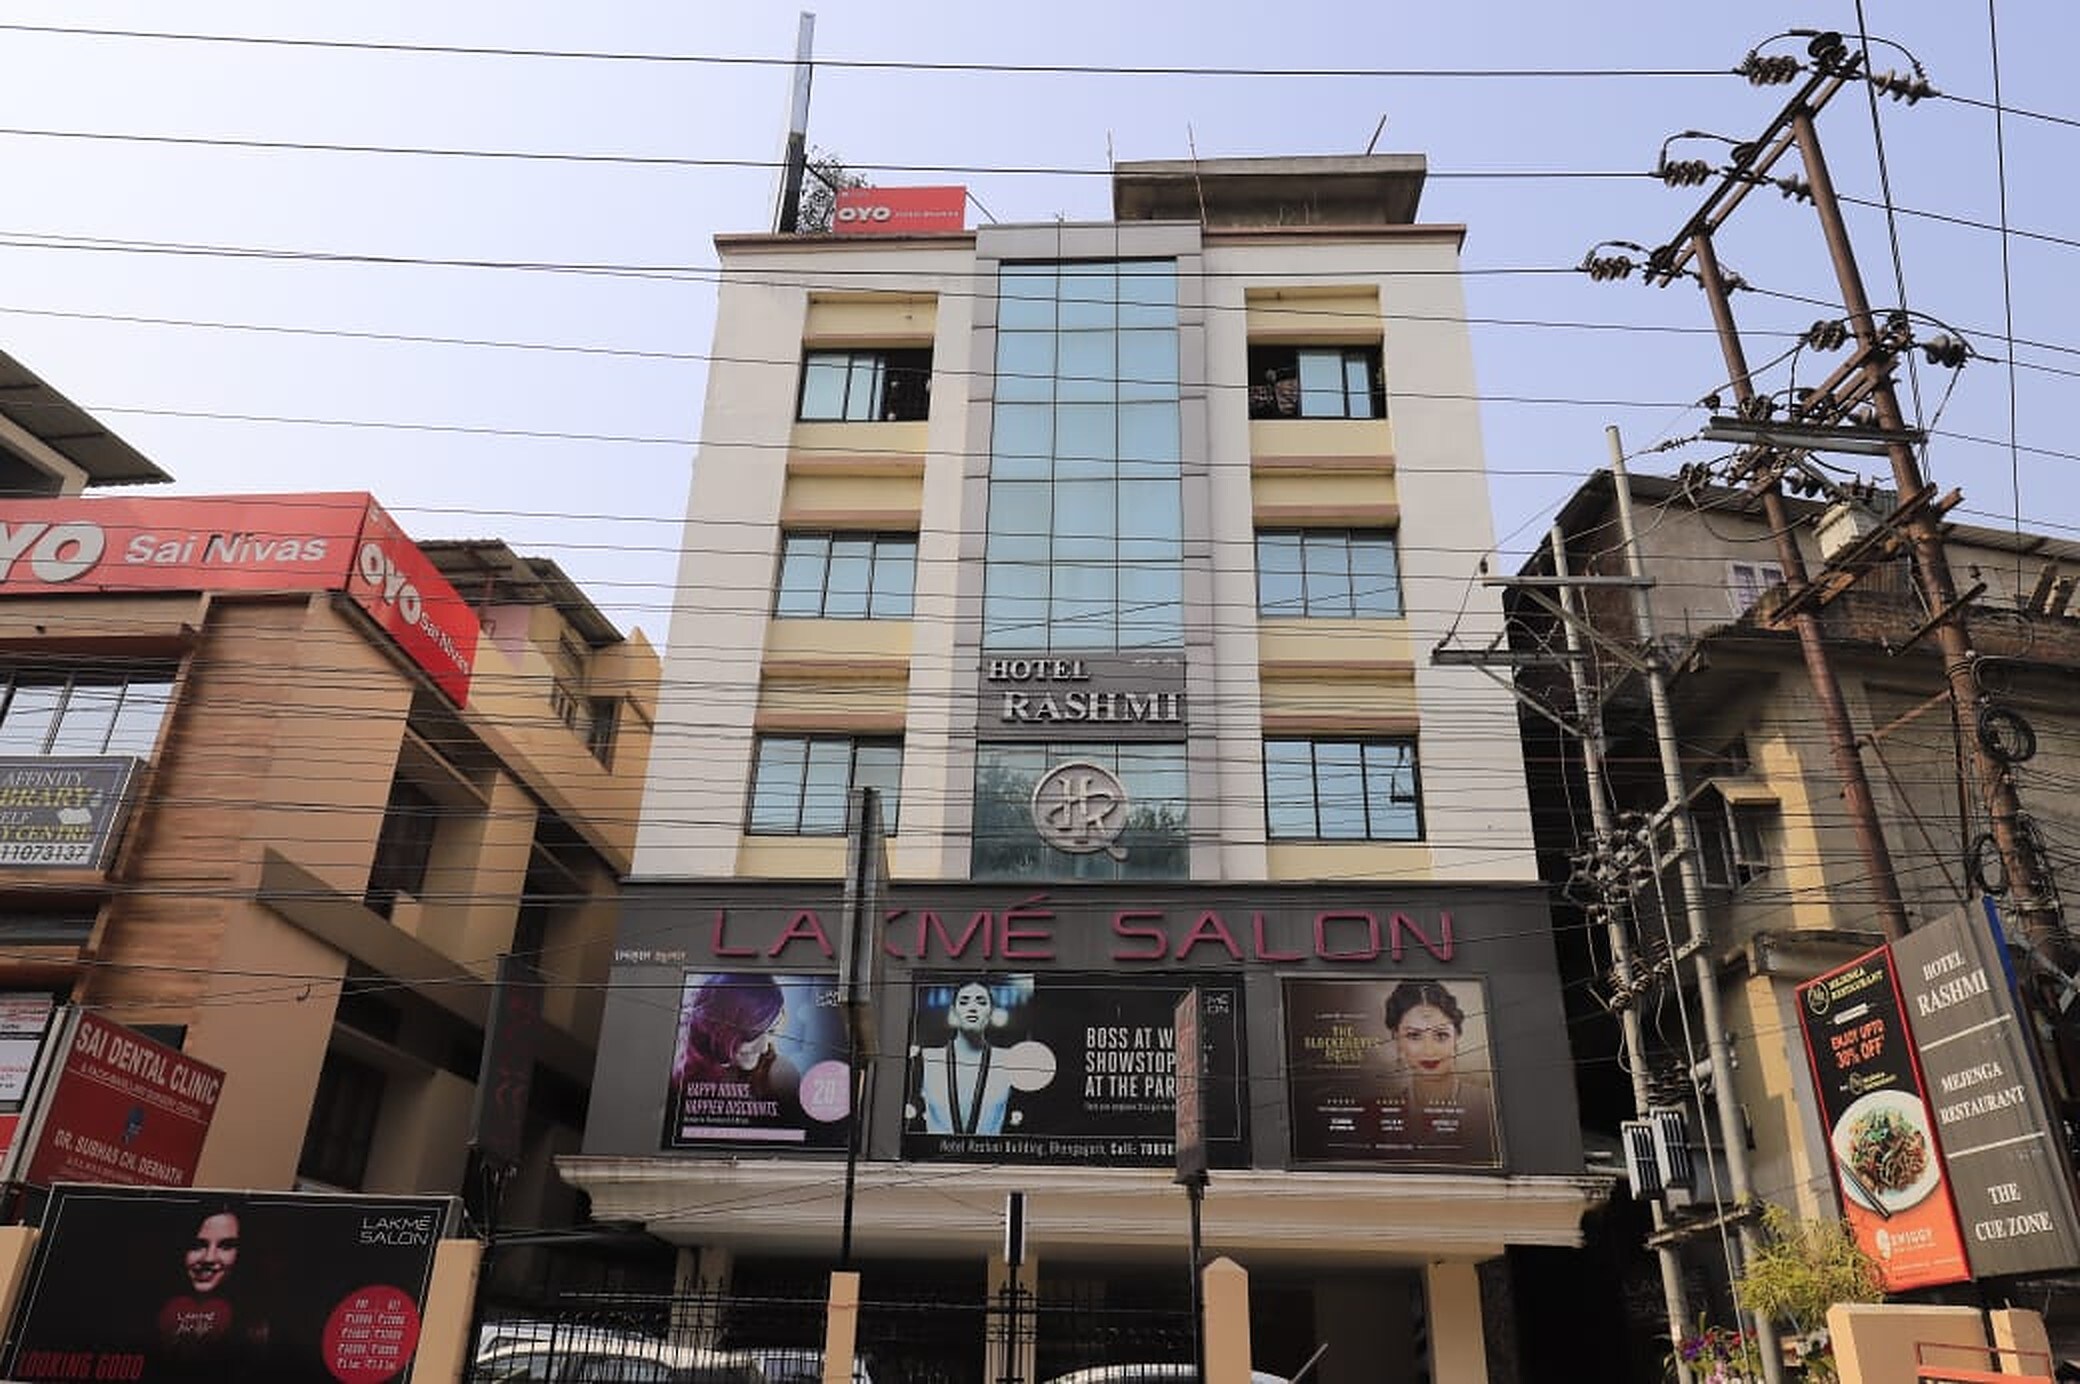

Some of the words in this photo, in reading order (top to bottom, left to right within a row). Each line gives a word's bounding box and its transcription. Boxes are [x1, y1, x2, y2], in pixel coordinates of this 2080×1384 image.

[839, 206, 890, 221] OYO
[124, 534, 198, 564] Sai
[203, 532, 328, 563] Nivas
[361, 543, 421, 625] OYO
[988, 659, 1089, 682] HOTEL
[1002, 692, 1181, 723] RASHMI
[1112, 909, 1454, 961] SALON
[1923, 950, 1966, 981] HOTEL
[1917, 968, 1990, 1016] RASHMI
[1087, 1027, 1128, 1049] BOSS
[1134, 1027, 1152, 1049] AT
[1861, 1034, 1884, 1059] OFF
[76, 1022, 109, 1058] SAI
[108, 1036, 165, 1085] DENTAL
[170, 1064, 220, 1105] CLINIC
[1085, 1051, 1176, 1073] SHOWSTOP
[1941, 1061, 2003, 1093] MEJENGA
[1085, 1075, 1102, 1097] AT
[1109, 1075, 1138, 1097] THE
[1144, 1076, 1176, 1098] PAR
[1940, 1085, 2027, 1125] RESTAURANT
[54, 1129, 73, 1151] DR.
[75, 1136, 118, 1165] SUBHAS
[1987, 1183, 2021, 1205] THE
[359, 1231, 429, 1245] SALON
[1975, 1220, 2007, 1241] CUE
[2007, 1211, 2053, 1237] ZONE
